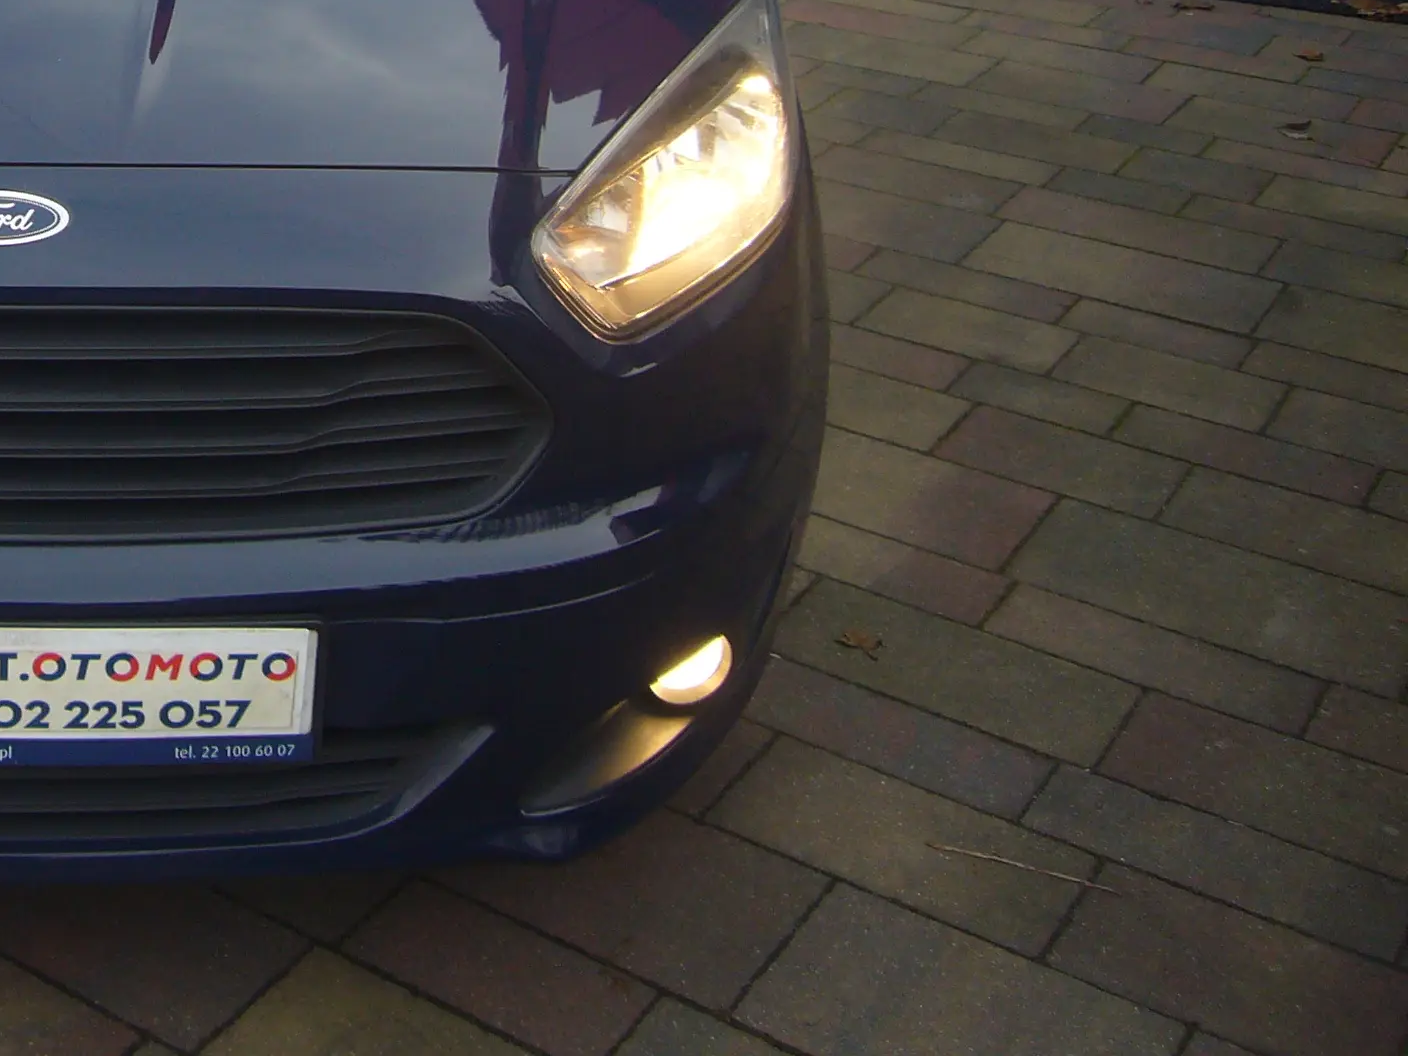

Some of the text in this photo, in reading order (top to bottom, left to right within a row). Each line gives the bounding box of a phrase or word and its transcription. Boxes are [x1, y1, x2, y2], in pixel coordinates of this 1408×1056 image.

[63, 700, 145, 729] 225
[159, 700, 252, 729] 057
[175, 744, 296, 759] tel. 22 100 60 07
